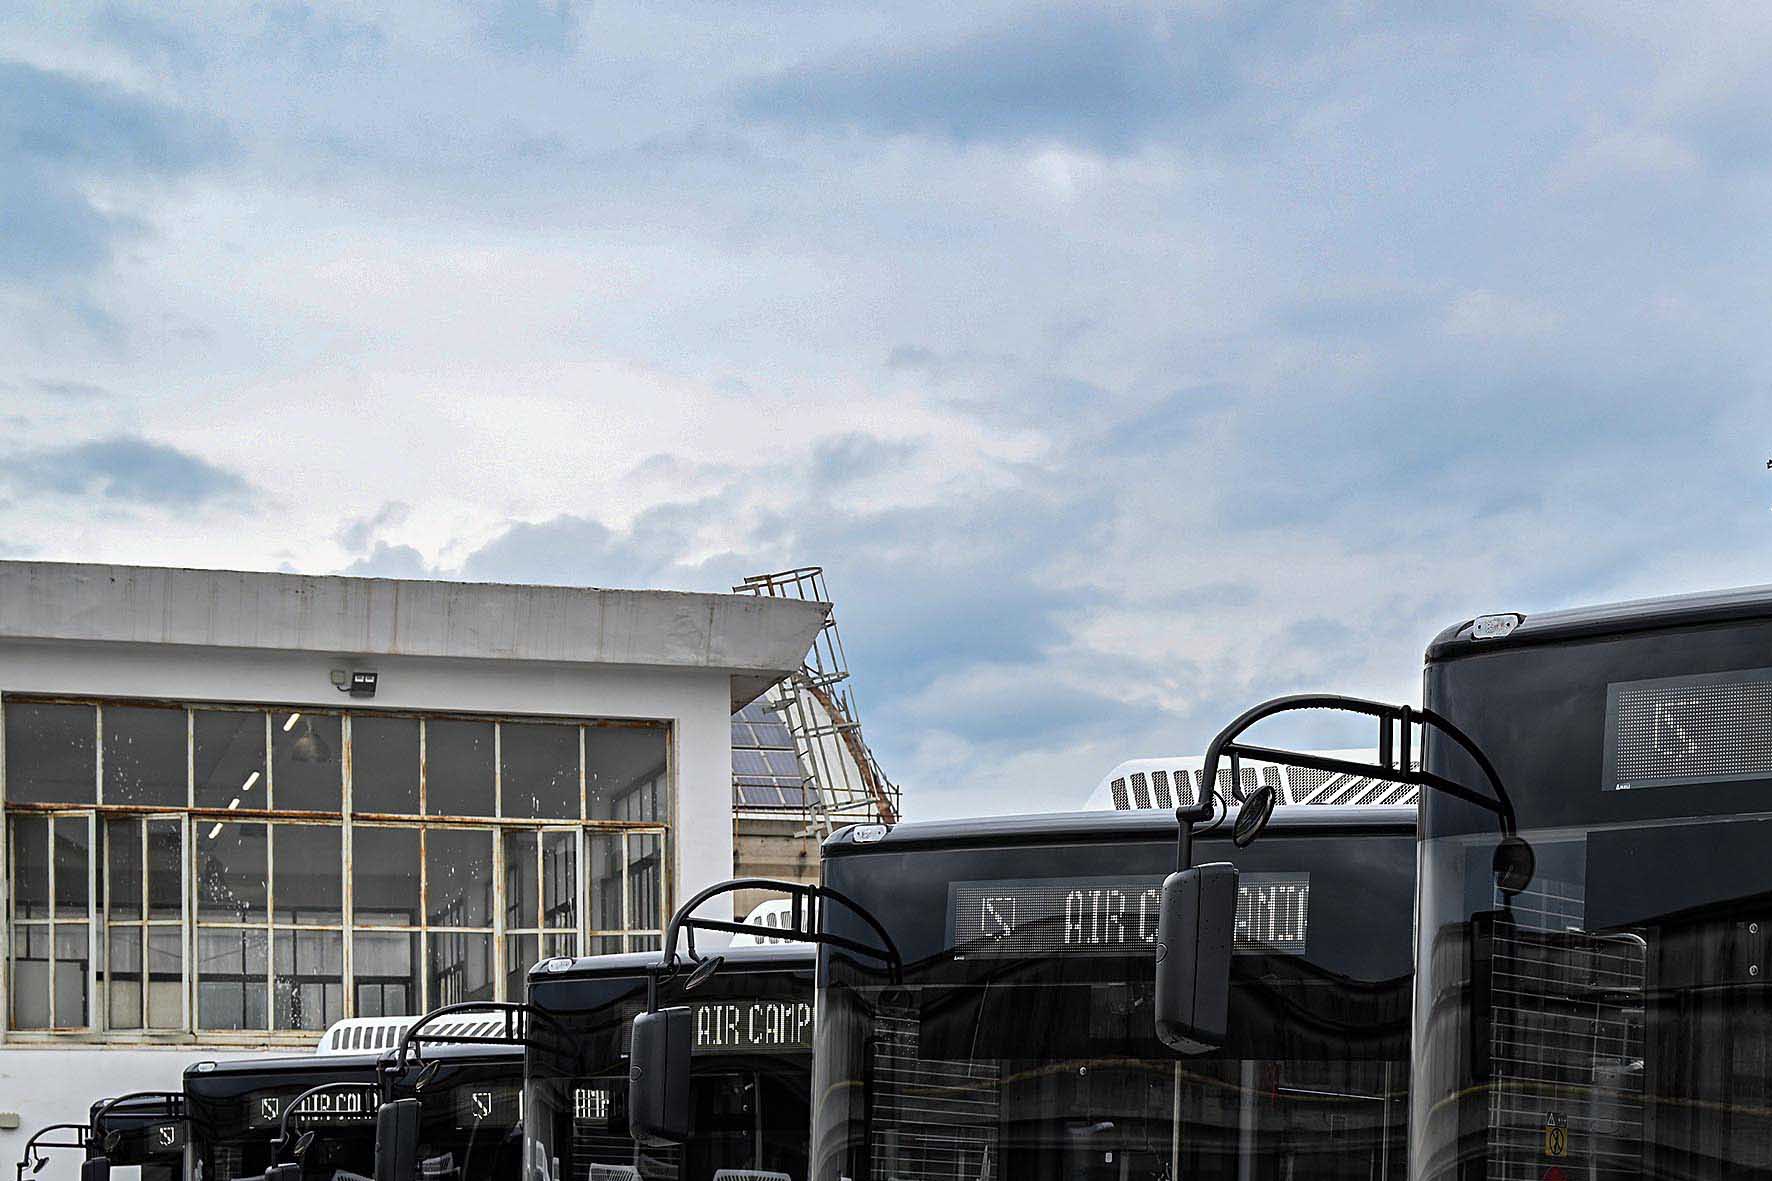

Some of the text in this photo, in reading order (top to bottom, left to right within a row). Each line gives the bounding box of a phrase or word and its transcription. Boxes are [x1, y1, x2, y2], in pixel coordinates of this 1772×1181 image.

[1063, 889, 1126, 943] AIR
[697, 1003, 815, 1046] AIR CAMP
